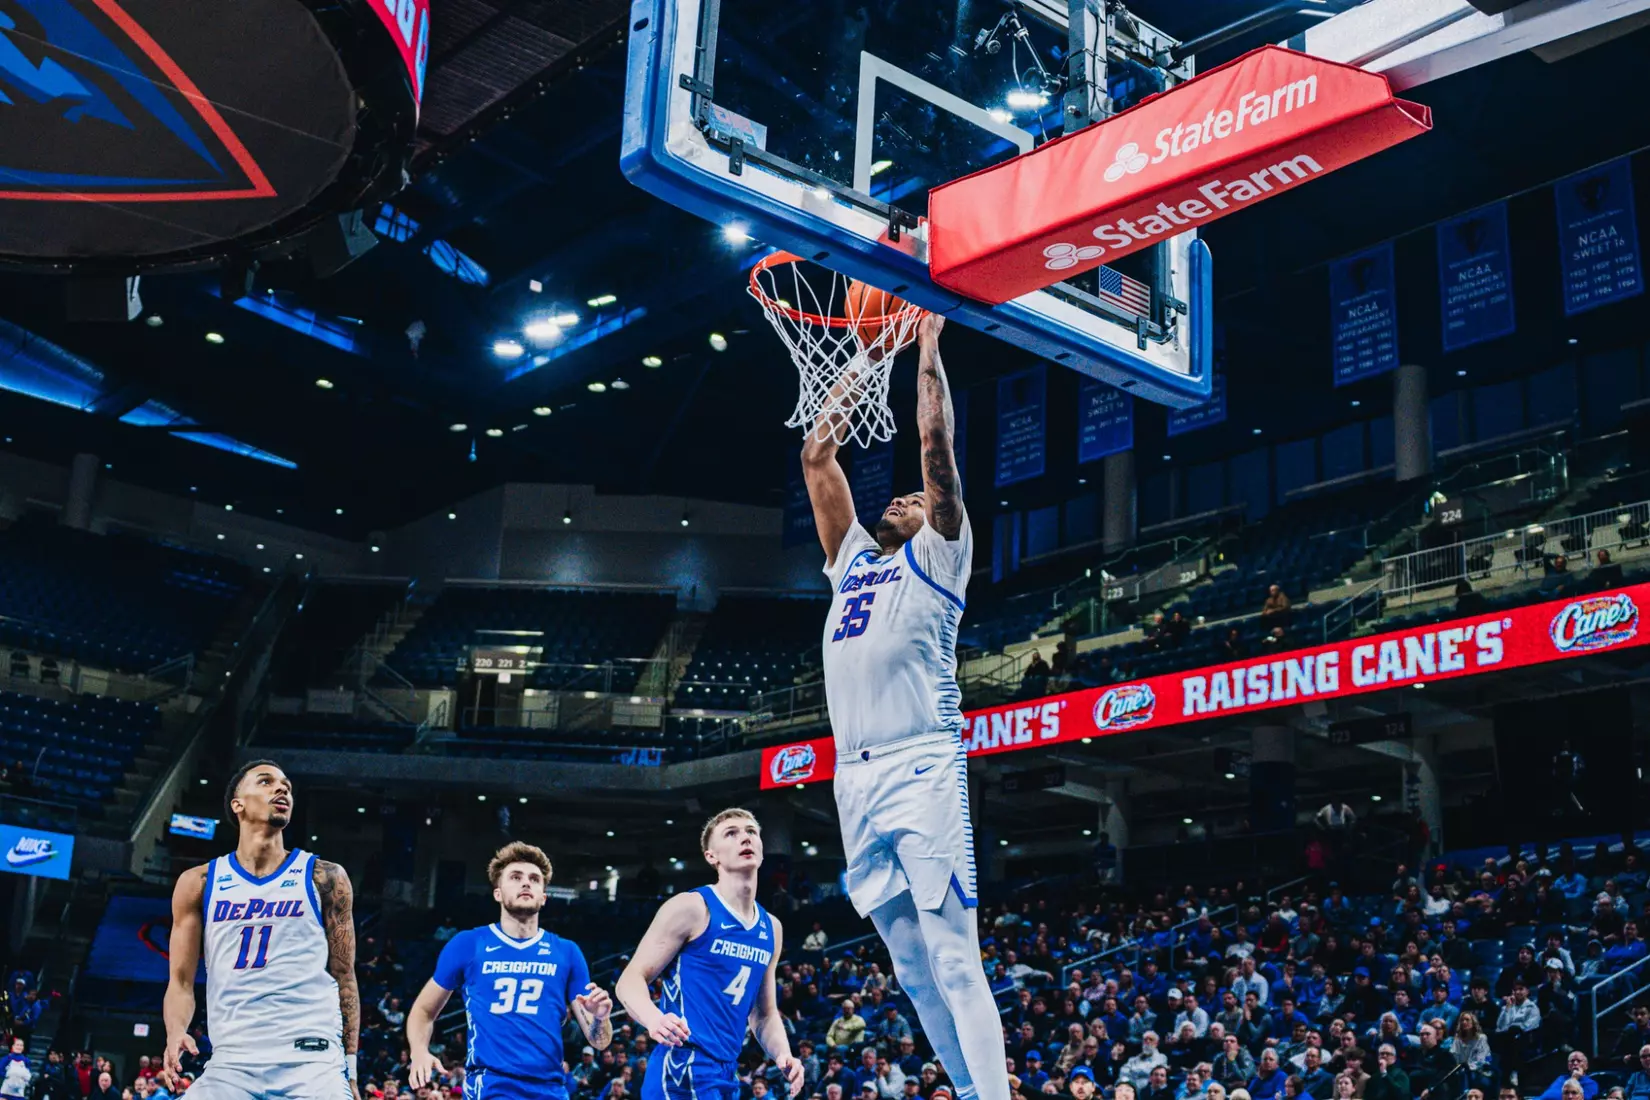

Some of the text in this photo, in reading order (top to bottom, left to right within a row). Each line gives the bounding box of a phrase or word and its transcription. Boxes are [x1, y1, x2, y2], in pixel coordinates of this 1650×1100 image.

[1572, 236, 1625, 262] SWEET 16
[1578, 223, 1617, 247] NCAA
[1458, 262, 1491, 282] NCAA
[1348, 300, 1378, 319] NCAA
[1441, 509, 1462, 524] 224
[832, 592, 877, 643] 35
[1555, 595, 1636, 649] Cane's
[475, 658, 492, 668] 220
[498, 658, 513, 668] 221
[1182, 619, 1504, 717] RAISING CANE'S
[1096, 684, 1152, 729] Cane's
[772, 746, 815, 782] Cane's
[15, 836, 51, 854] NIKE
[233, 925, 273, 970] 11
[709, 938, 772, 967] CREIGHTON
[482, 961, 557, 976] CREIGHTON
[489, 977, 544, 1014] 32
[722, 965, 752, 1006] 4
